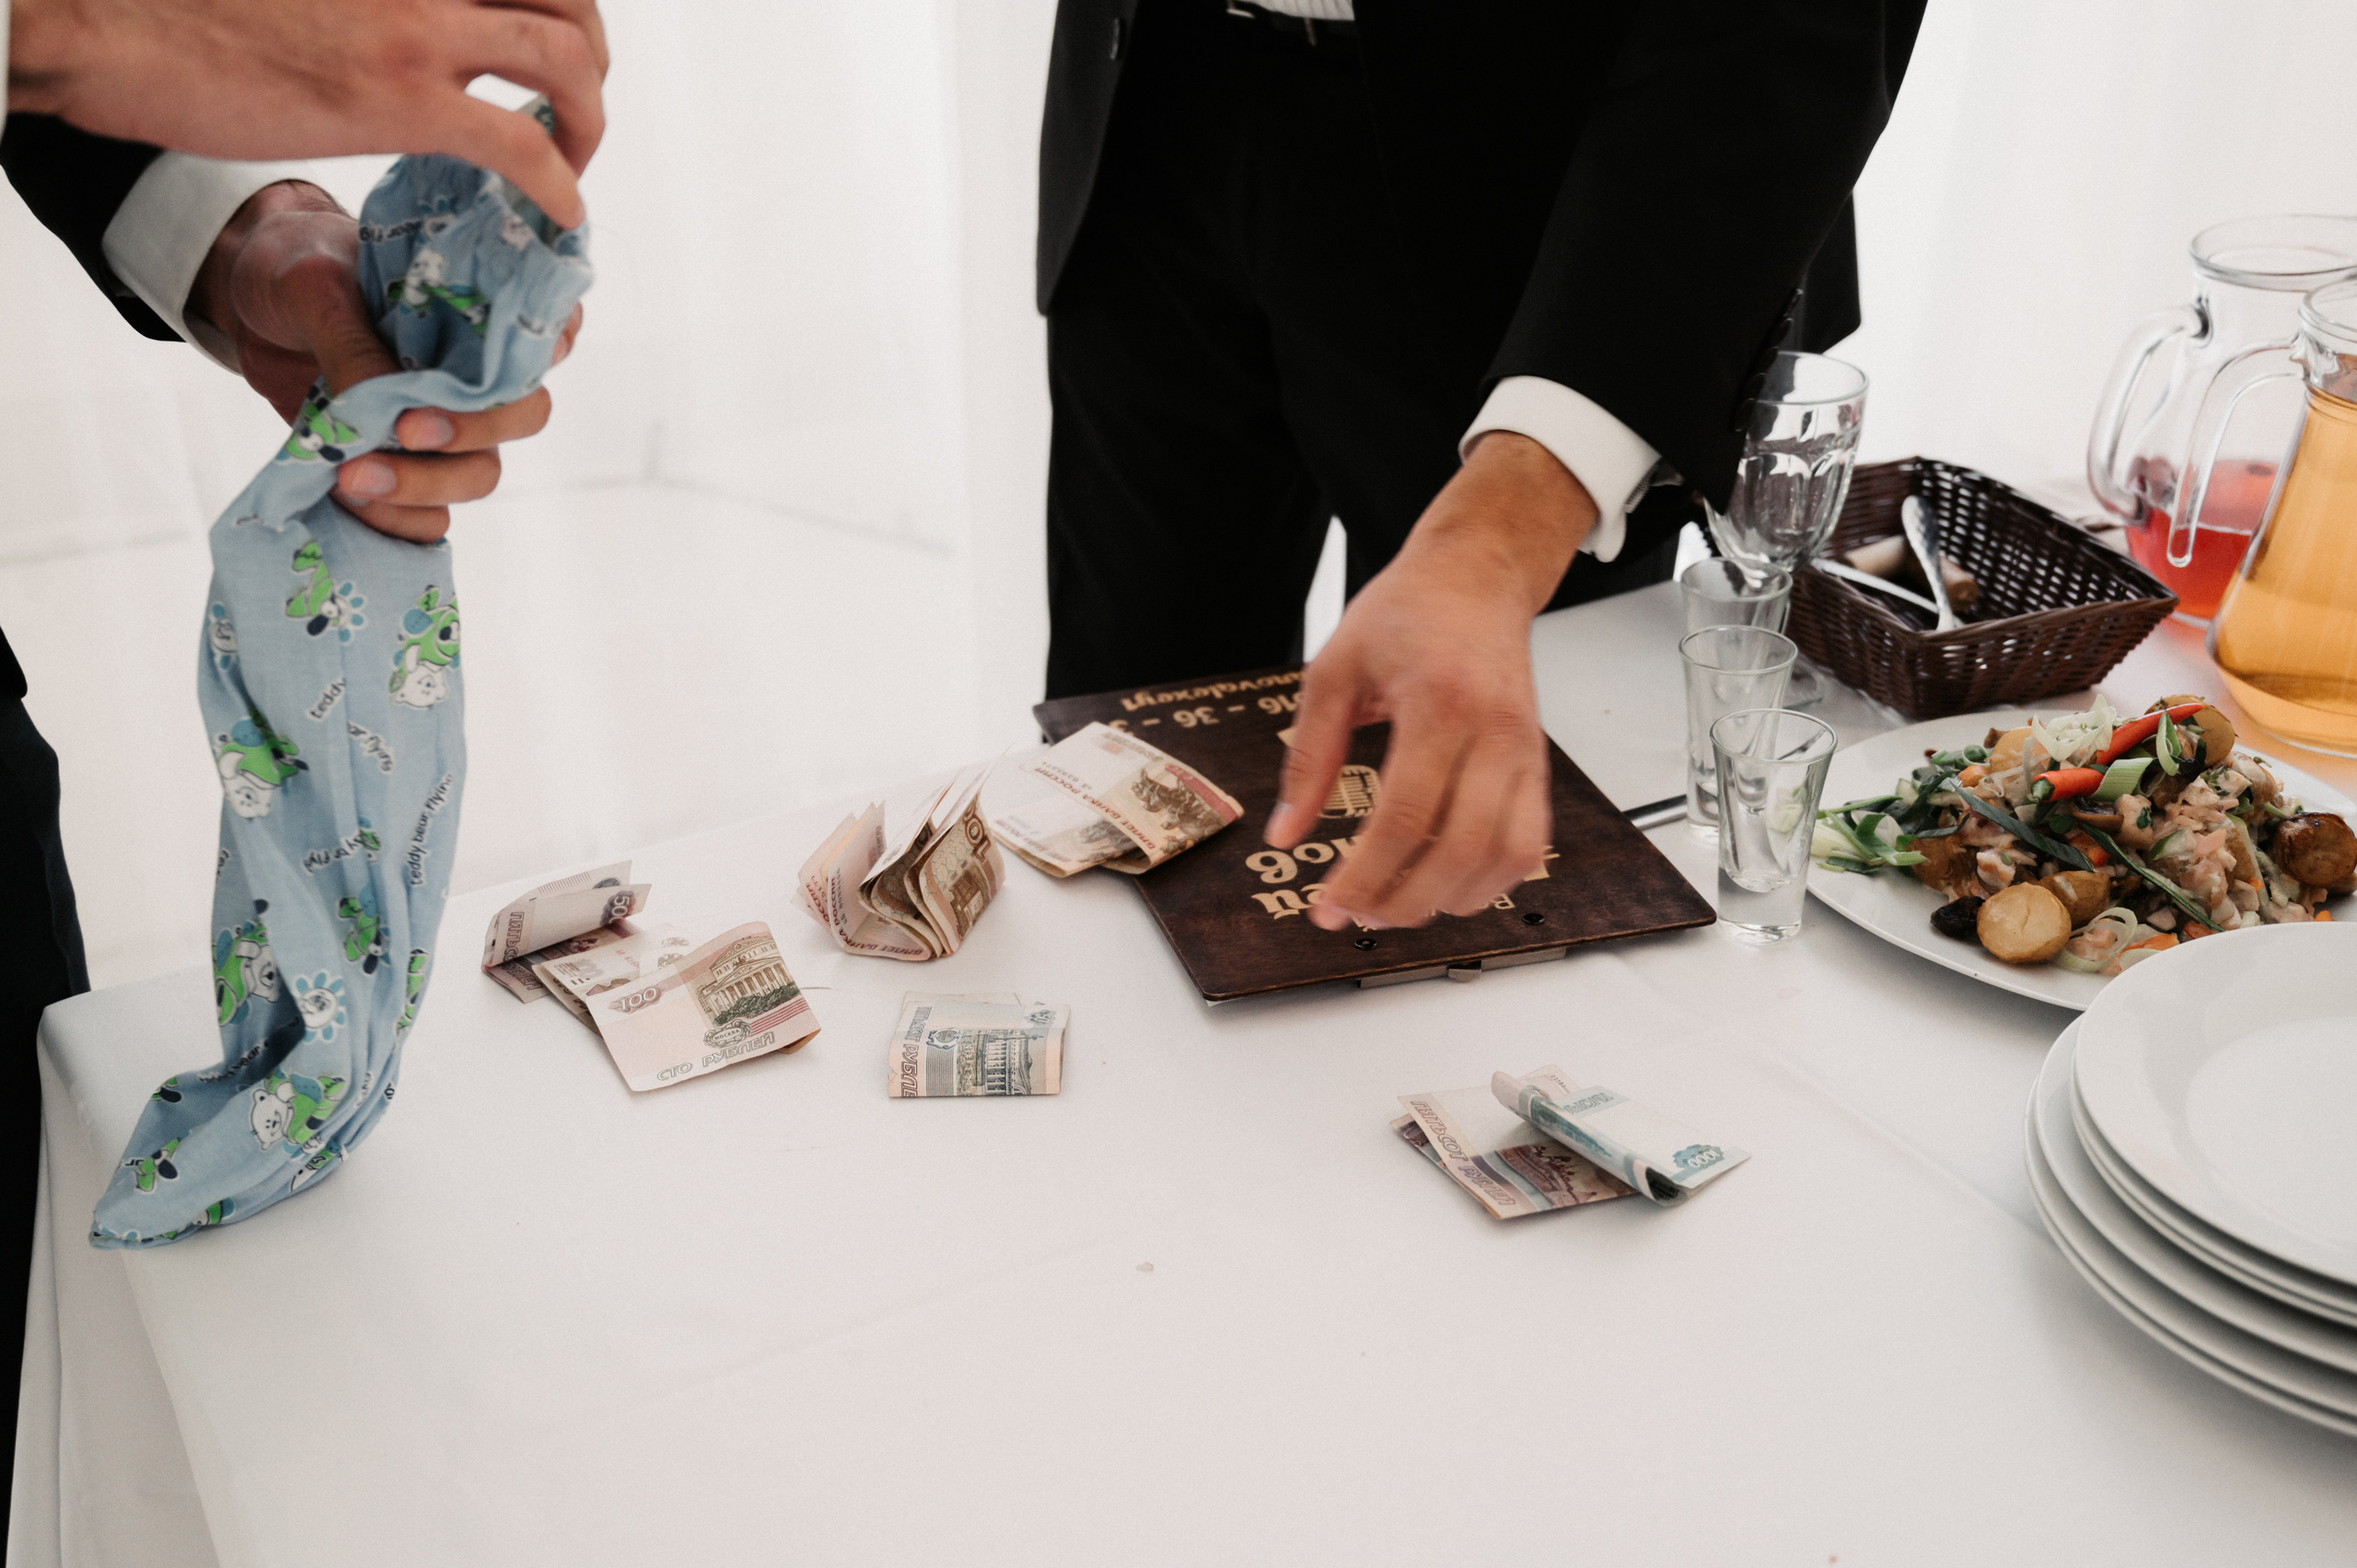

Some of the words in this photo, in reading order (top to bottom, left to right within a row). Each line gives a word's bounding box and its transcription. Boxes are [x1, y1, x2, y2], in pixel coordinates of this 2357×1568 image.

[1173, 706, 1219, 728] 36
[806, 881, 831, 926] ОССИИ
[503, 911, 525, 963] ПЯТЬСО
[619, 987, 658, 1012] 100
[656, 1062, 693, 1081] СТО
[702, 1030, 776, 1067] РУБЛЕЙ
[714, 1028, 741, 1041] МОСКВА
[901, 1043, 919, 1098] РУБЛЕ
[1410, 1099, 1469, 1161] ПЯТЬСОТ
[1457, 1165, 1516, 1206] РУБЛЕЙ
[1687, 1148, 1721, 1169] 1000
